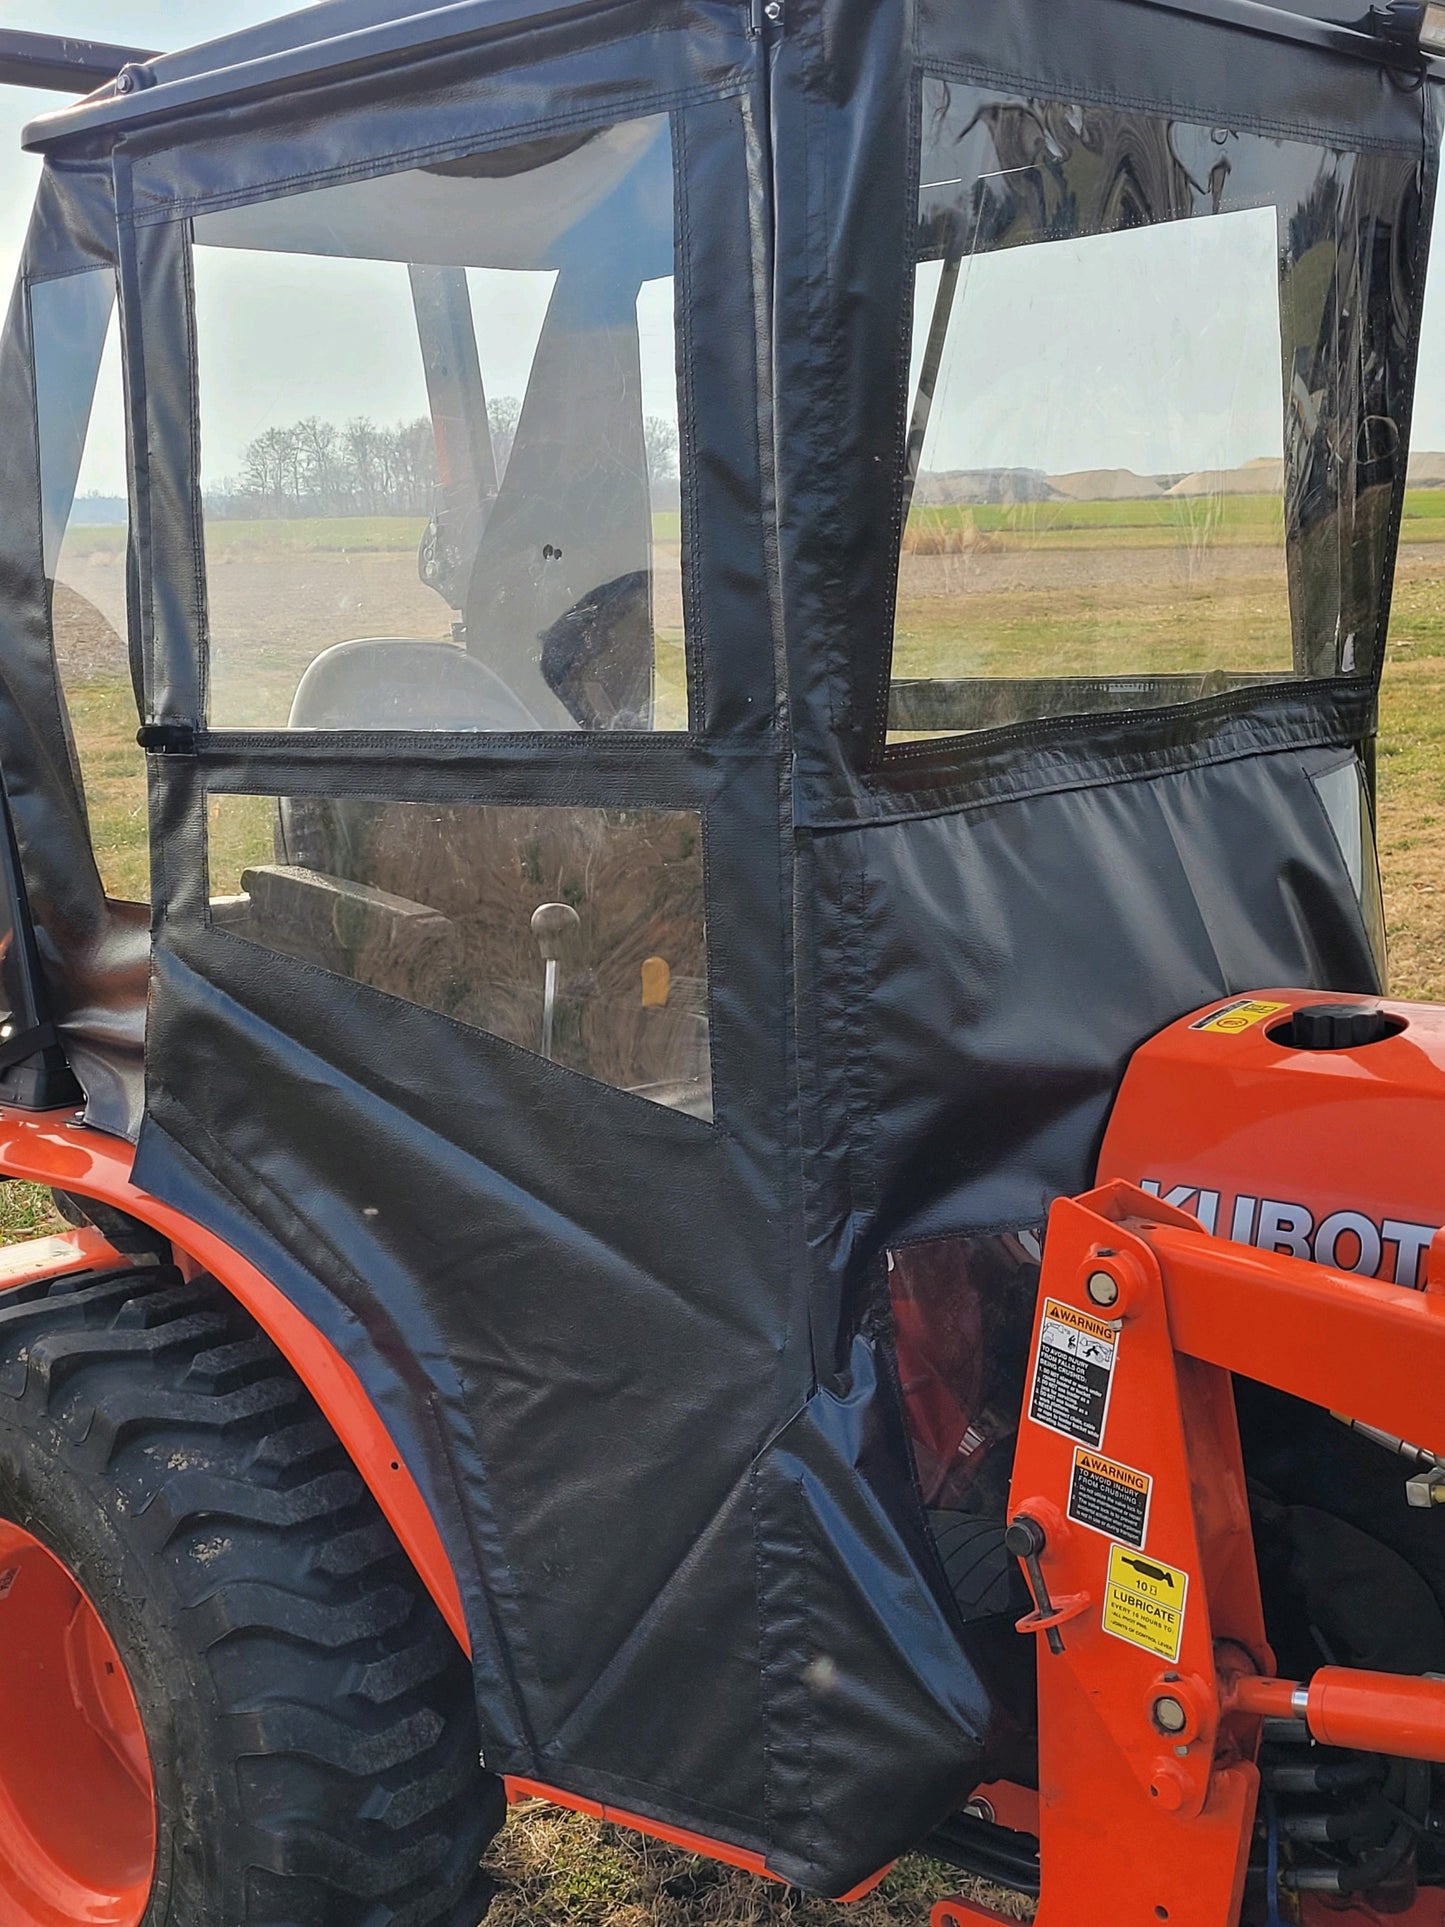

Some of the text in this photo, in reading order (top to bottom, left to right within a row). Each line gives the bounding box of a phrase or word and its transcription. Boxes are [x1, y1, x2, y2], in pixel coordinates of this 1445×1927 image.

[1140, 1179, 1430, 1293] UBOT
[1060, 1309, 1112, 1339] WARNING
[1039, 1359, 1058, 1370] BEING
[1040, 1352, 1085, 1375] FROM FALLS OR
[1041, 1345, 1089, 1369] TO AVOID INJURY
[1079, 1469, 1139, 1498] TO AVOID INJURY
[1092, 1458, 1144, 1488] WARNING
[1078, 1476, 1098, 1488] FROM
[1100, 1485, 1137, 1505] CRUSHING
[1136, 1580, 1147, 1591] 10
[1111, 1602, 1130, 1614] EVERY
[1141, 1615, 1162, 1628] HOURS
[1113, 1589, 1174, 1623] LUBRICATE
